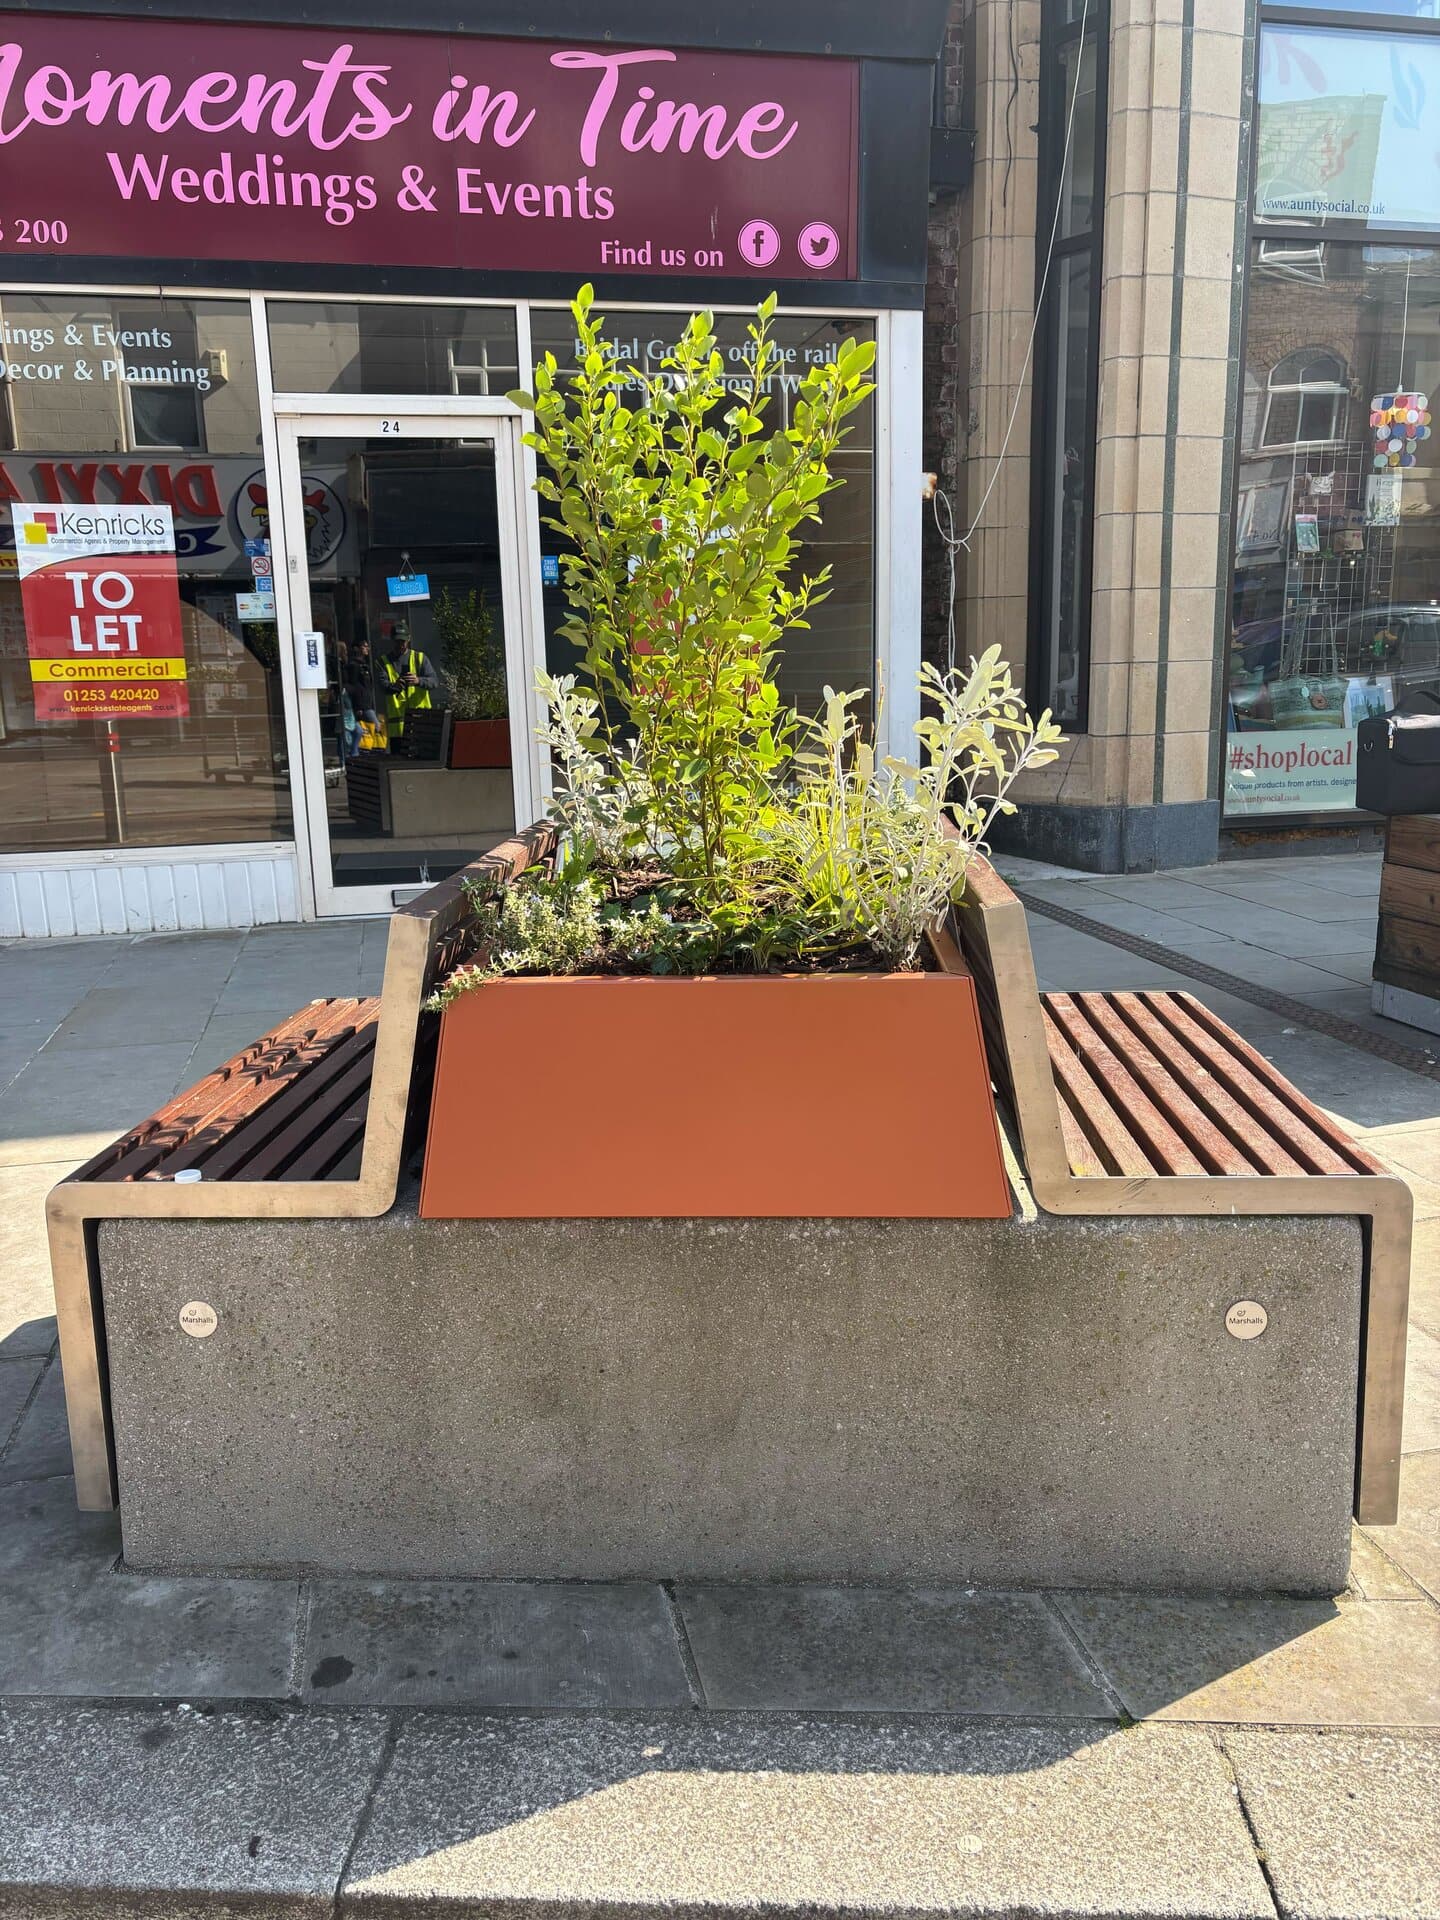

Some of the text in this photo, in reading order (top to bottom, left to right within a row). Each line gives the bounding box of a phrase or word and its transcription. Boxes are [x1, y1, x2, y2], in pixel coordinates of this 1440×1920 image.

[432, 75, 536, 148] in
[550, 49, 798, 167] Time
[106, 152, 615, 226] Weddings & Events
[1262, 199, 1385, 215] www.auntysocial.co.uk
[16, 220, 68, 244] 200
[601, 241, 651, 266] Find
[661, 249, 686, 267] us
[694, 249, 724, 267] on
[0, 320, 172, 352] ings & Events
[728, 341, 759, 362] off
[766, 341, 797, 363] he
[804, 343, 837, 363] rail
[74, 359, 93, 381] &
[102, 358, 211, 391] Planning
[382, 420, 400, 433] 24
[61, 512, 165, 536] Kenricks
[65, 571, 134, 609] TO
[70, 615, 142, 652] LET
[49, 662, 169, 678] Commercial
[63, 689, 160, 702] 01253 420420
[1230, 740, 1353, 772] #shoplocal
[1255, 781, 1286, 790] products
[1287, 780, 1304, 788] from
